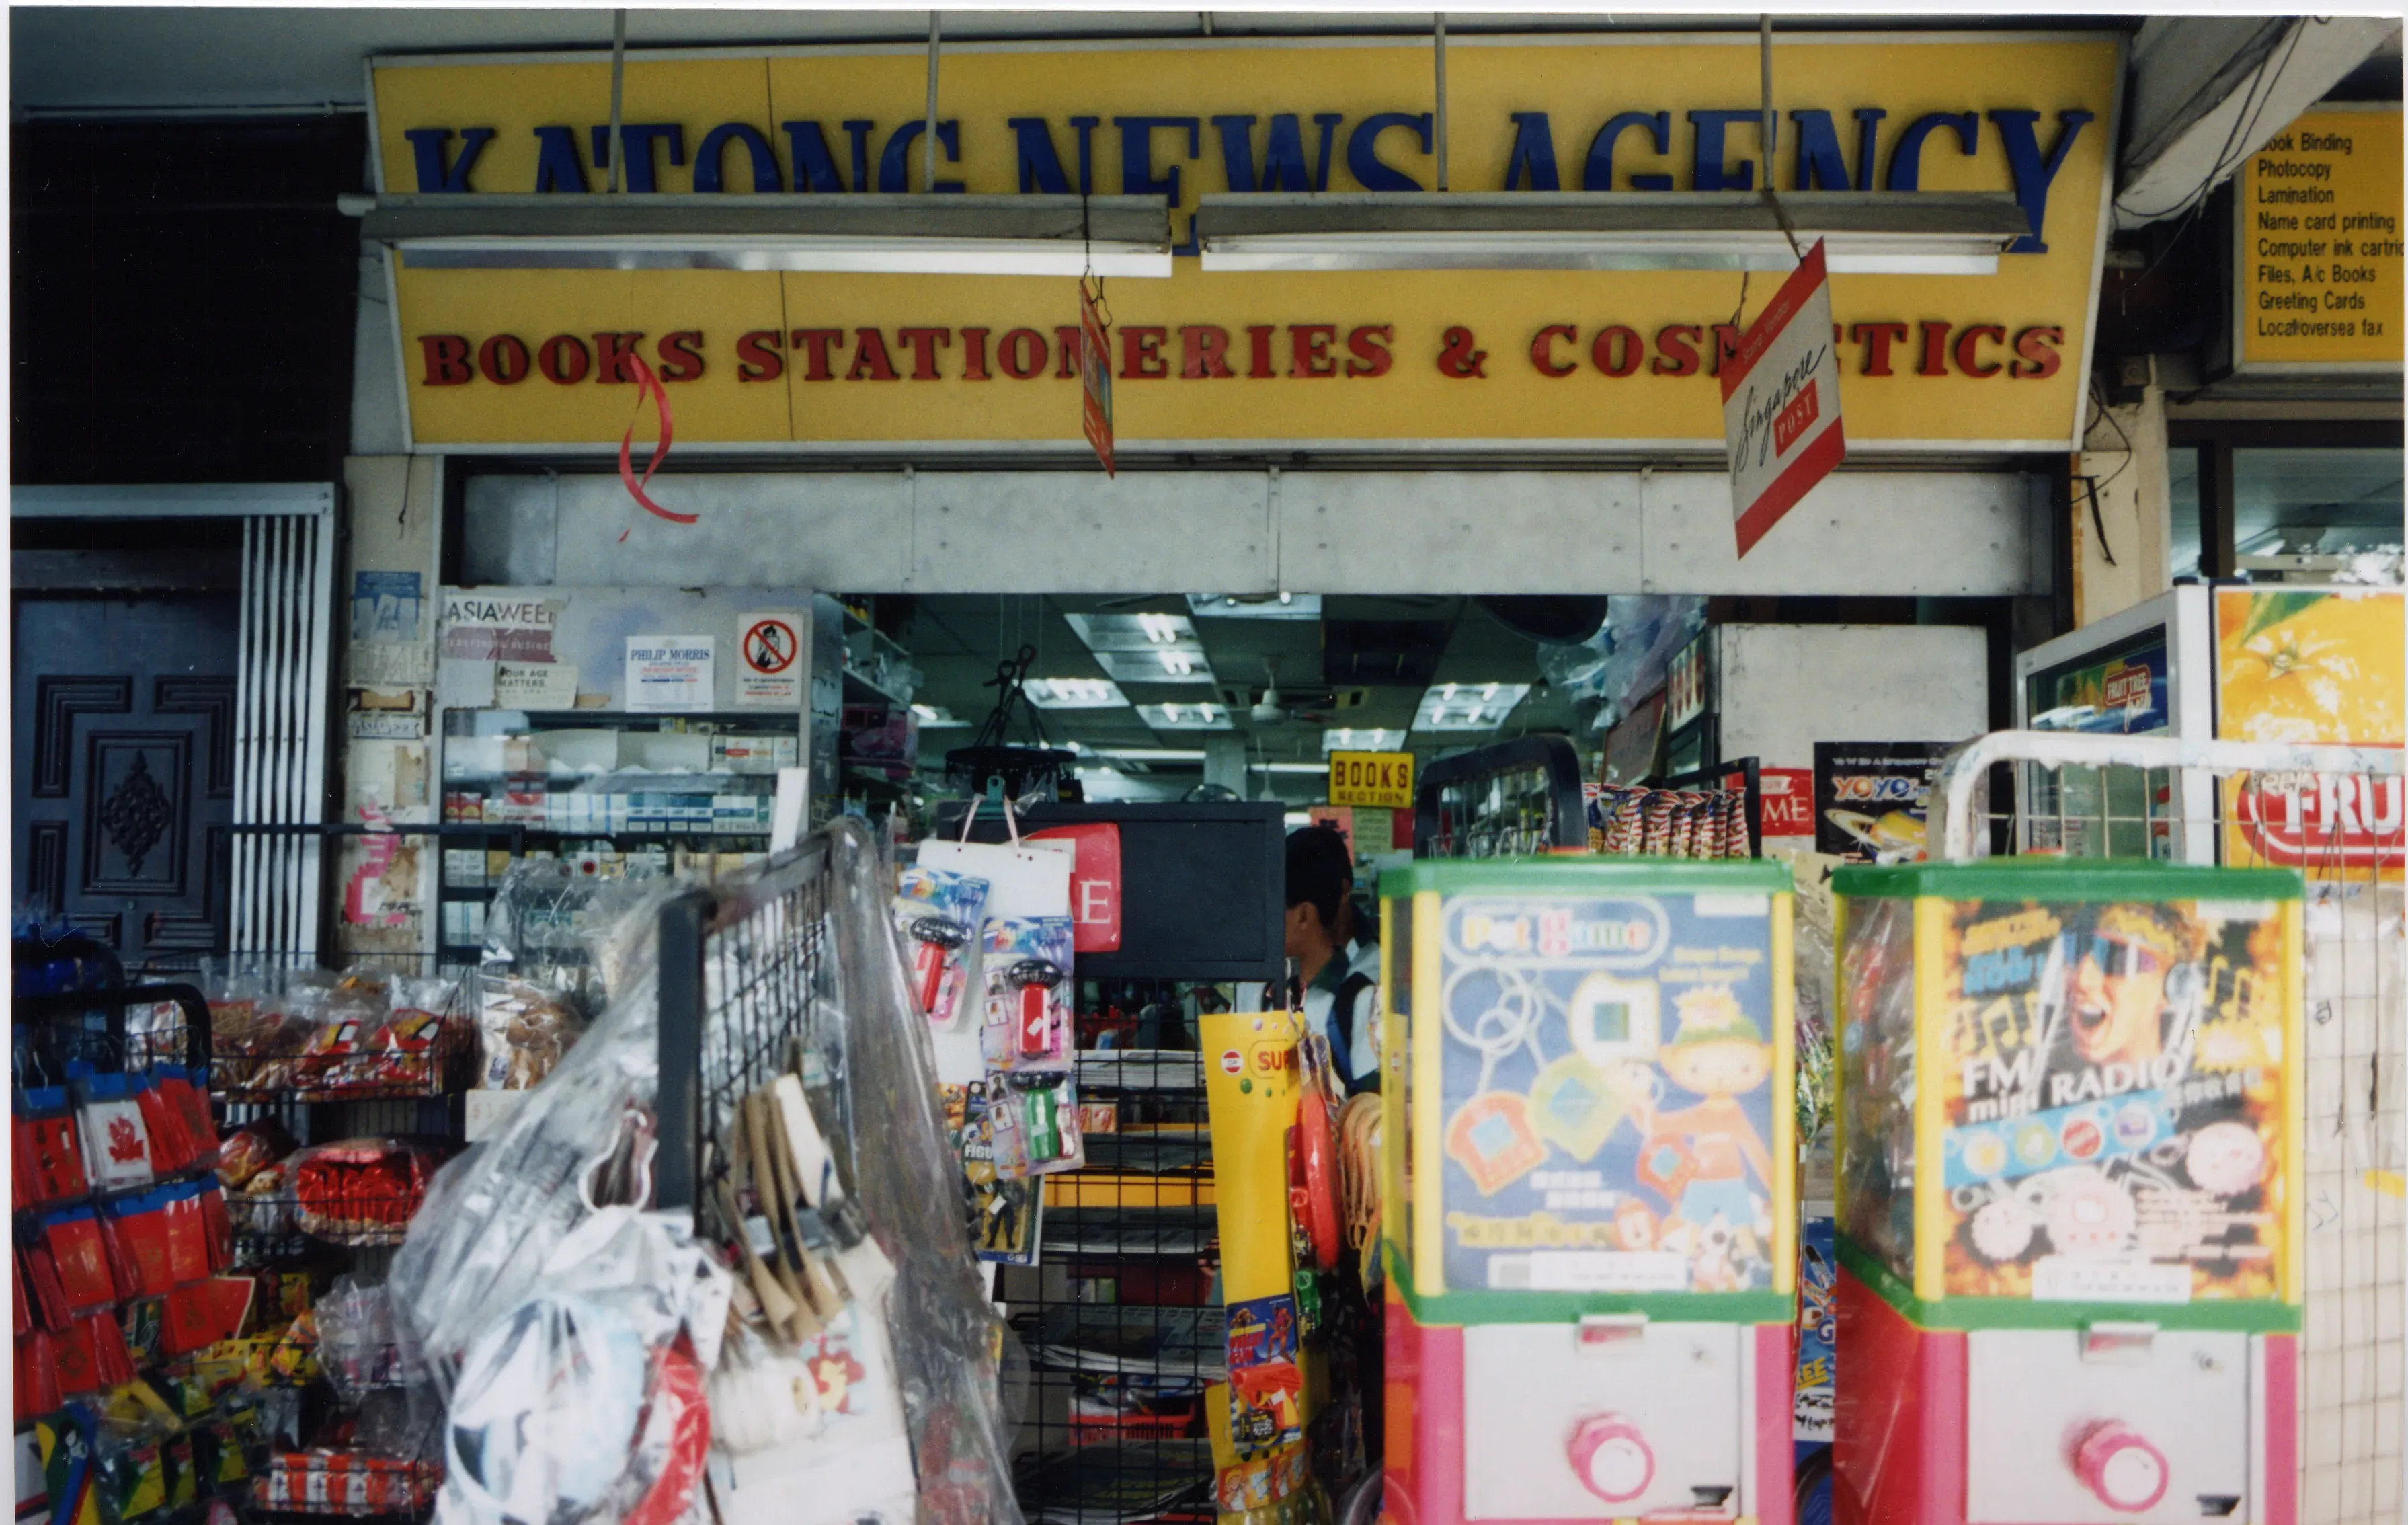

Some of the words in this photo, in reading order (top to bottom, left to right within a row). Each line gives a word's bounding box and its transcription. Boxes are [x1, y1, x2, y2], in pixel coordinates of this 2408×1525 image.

[2300, 132, 2352, 155] Binding
[2258, 159, 2331, 181] Photocopy
[405, 119, 965, 194] KATONG
[1008, 112, 1433, 256] NEWS
[1504, 108, 2095, 254] AGENCY
[2258, 186, 2334, 204] Lamination
[2257, 212, 2299, 231] Name
[2304, 212, 2336, 231] card
[2342, 212, 2395, 234] printing
[2257, 238, 2327, 260] Computer
[2333, 238, 2353, 257] ink
[2332, 264, 2376, 283] Books
[2258, 290, 2318, 313] Greeting
[2324, 290, 2365, 310] Cards
[2362, 318, 2384, 336] fax
[417, 329, 705, 385] BOOKS
[1437, 325, 1486, 379] &
[1530, 321, 2065, 379] COSTICS
[1777, 391, 1815, 444] POST
[630, 648, 666, 661] PHILIP
[670, 648, 711, 660] MORRIS
[530, 669, 549, 678] AGE
[2107, 678, 2127, 701] FRUIT
[2127, 672, 2147, 695] TREE
[1334, 760, 1408, 789] BOOKS
[1962, 1050, 2033, 1097] FM
[2052, 1053, 2189, 1107] RADIO
[1968, 1088, 2040, 1122] mini
[1796, 1356, 1827, 1384] EE
